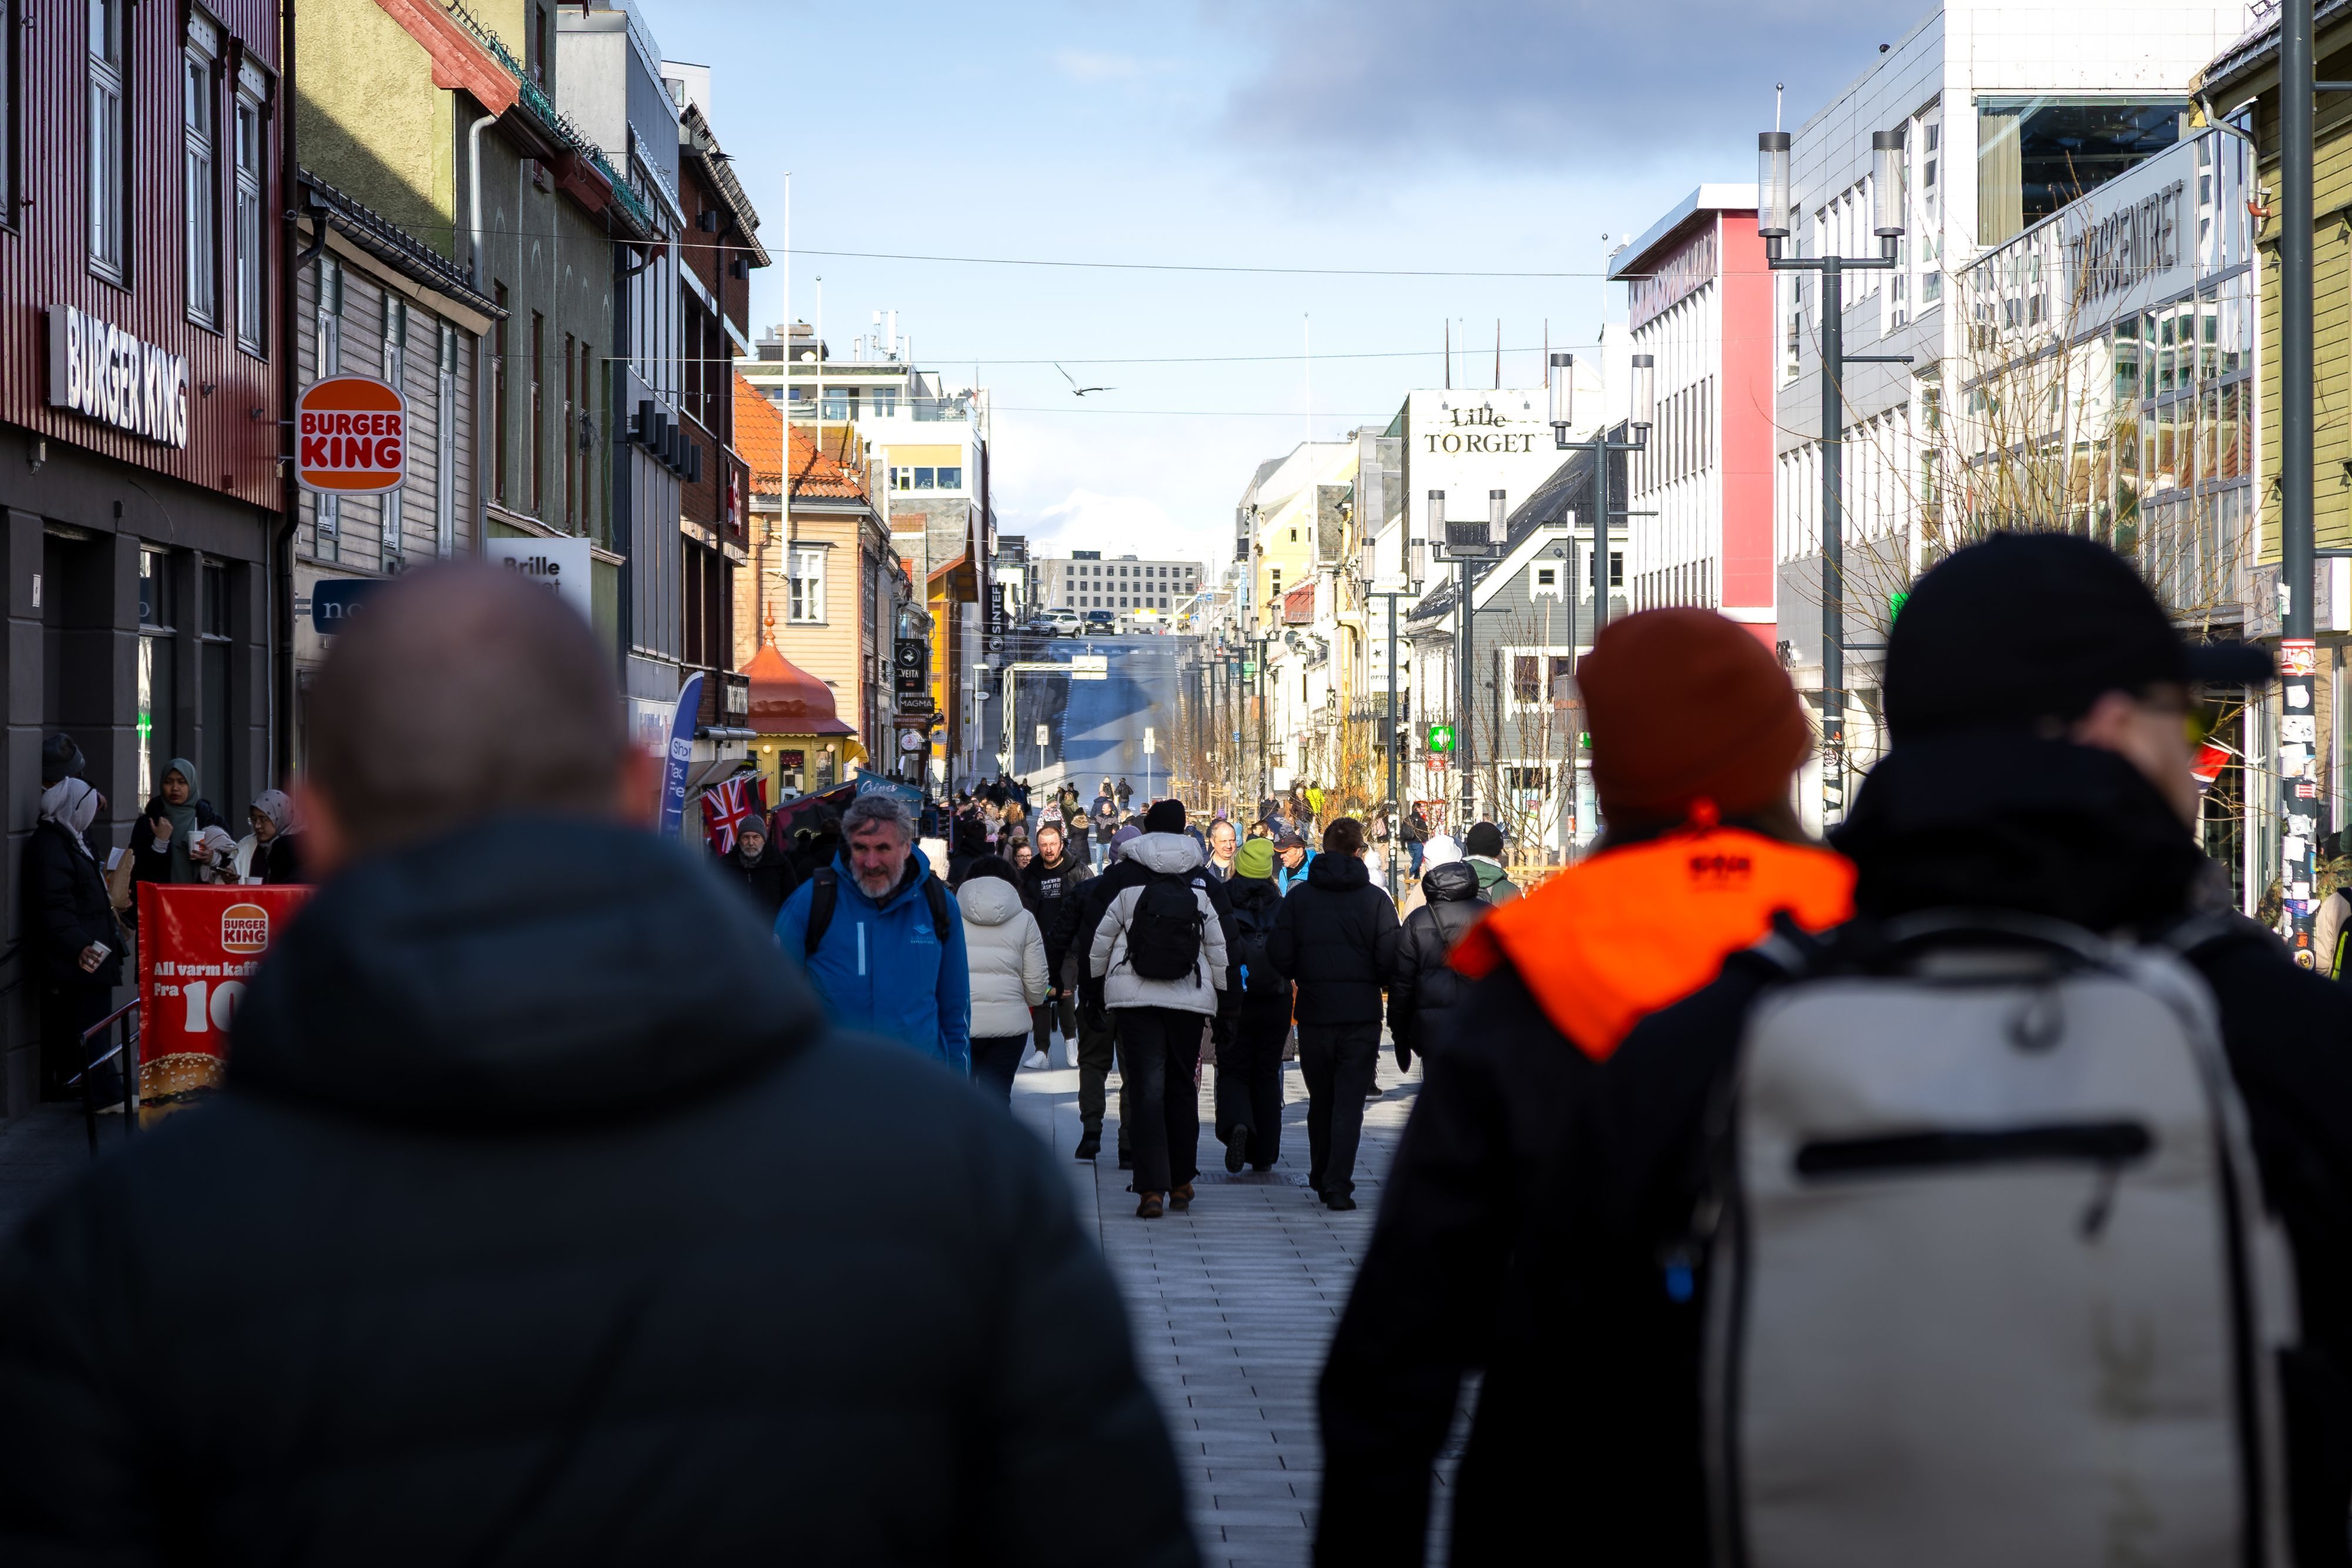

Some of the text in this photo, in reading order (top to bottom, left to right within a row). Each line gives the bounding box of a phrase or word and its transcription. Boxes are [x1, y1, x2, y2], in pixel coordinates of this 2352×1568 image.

[67, 305, 189, 449] BURGER KING
[300, 413, 402, 436] BURGER
[1450, 407, 1506, 427] Lille
[300, 436, 402, 469] KING
[1424, 433, 1536, 453] TORGET
[504, 556, 560, 576] Brille
[992, 587, 1001, 634] SINTEF
[901, 669, 918, 678] VEITA
[1328, 691, 1336, 725] KINO
[860, 780, 898, 794] Crêpes
[223, 920, 266, 930] BURGER
[223, 930, 266, 943] KING
[154, 961, 175, 976] All
[177, 964, 220, 976] varm
[154, 982, 179, 997] Fra
